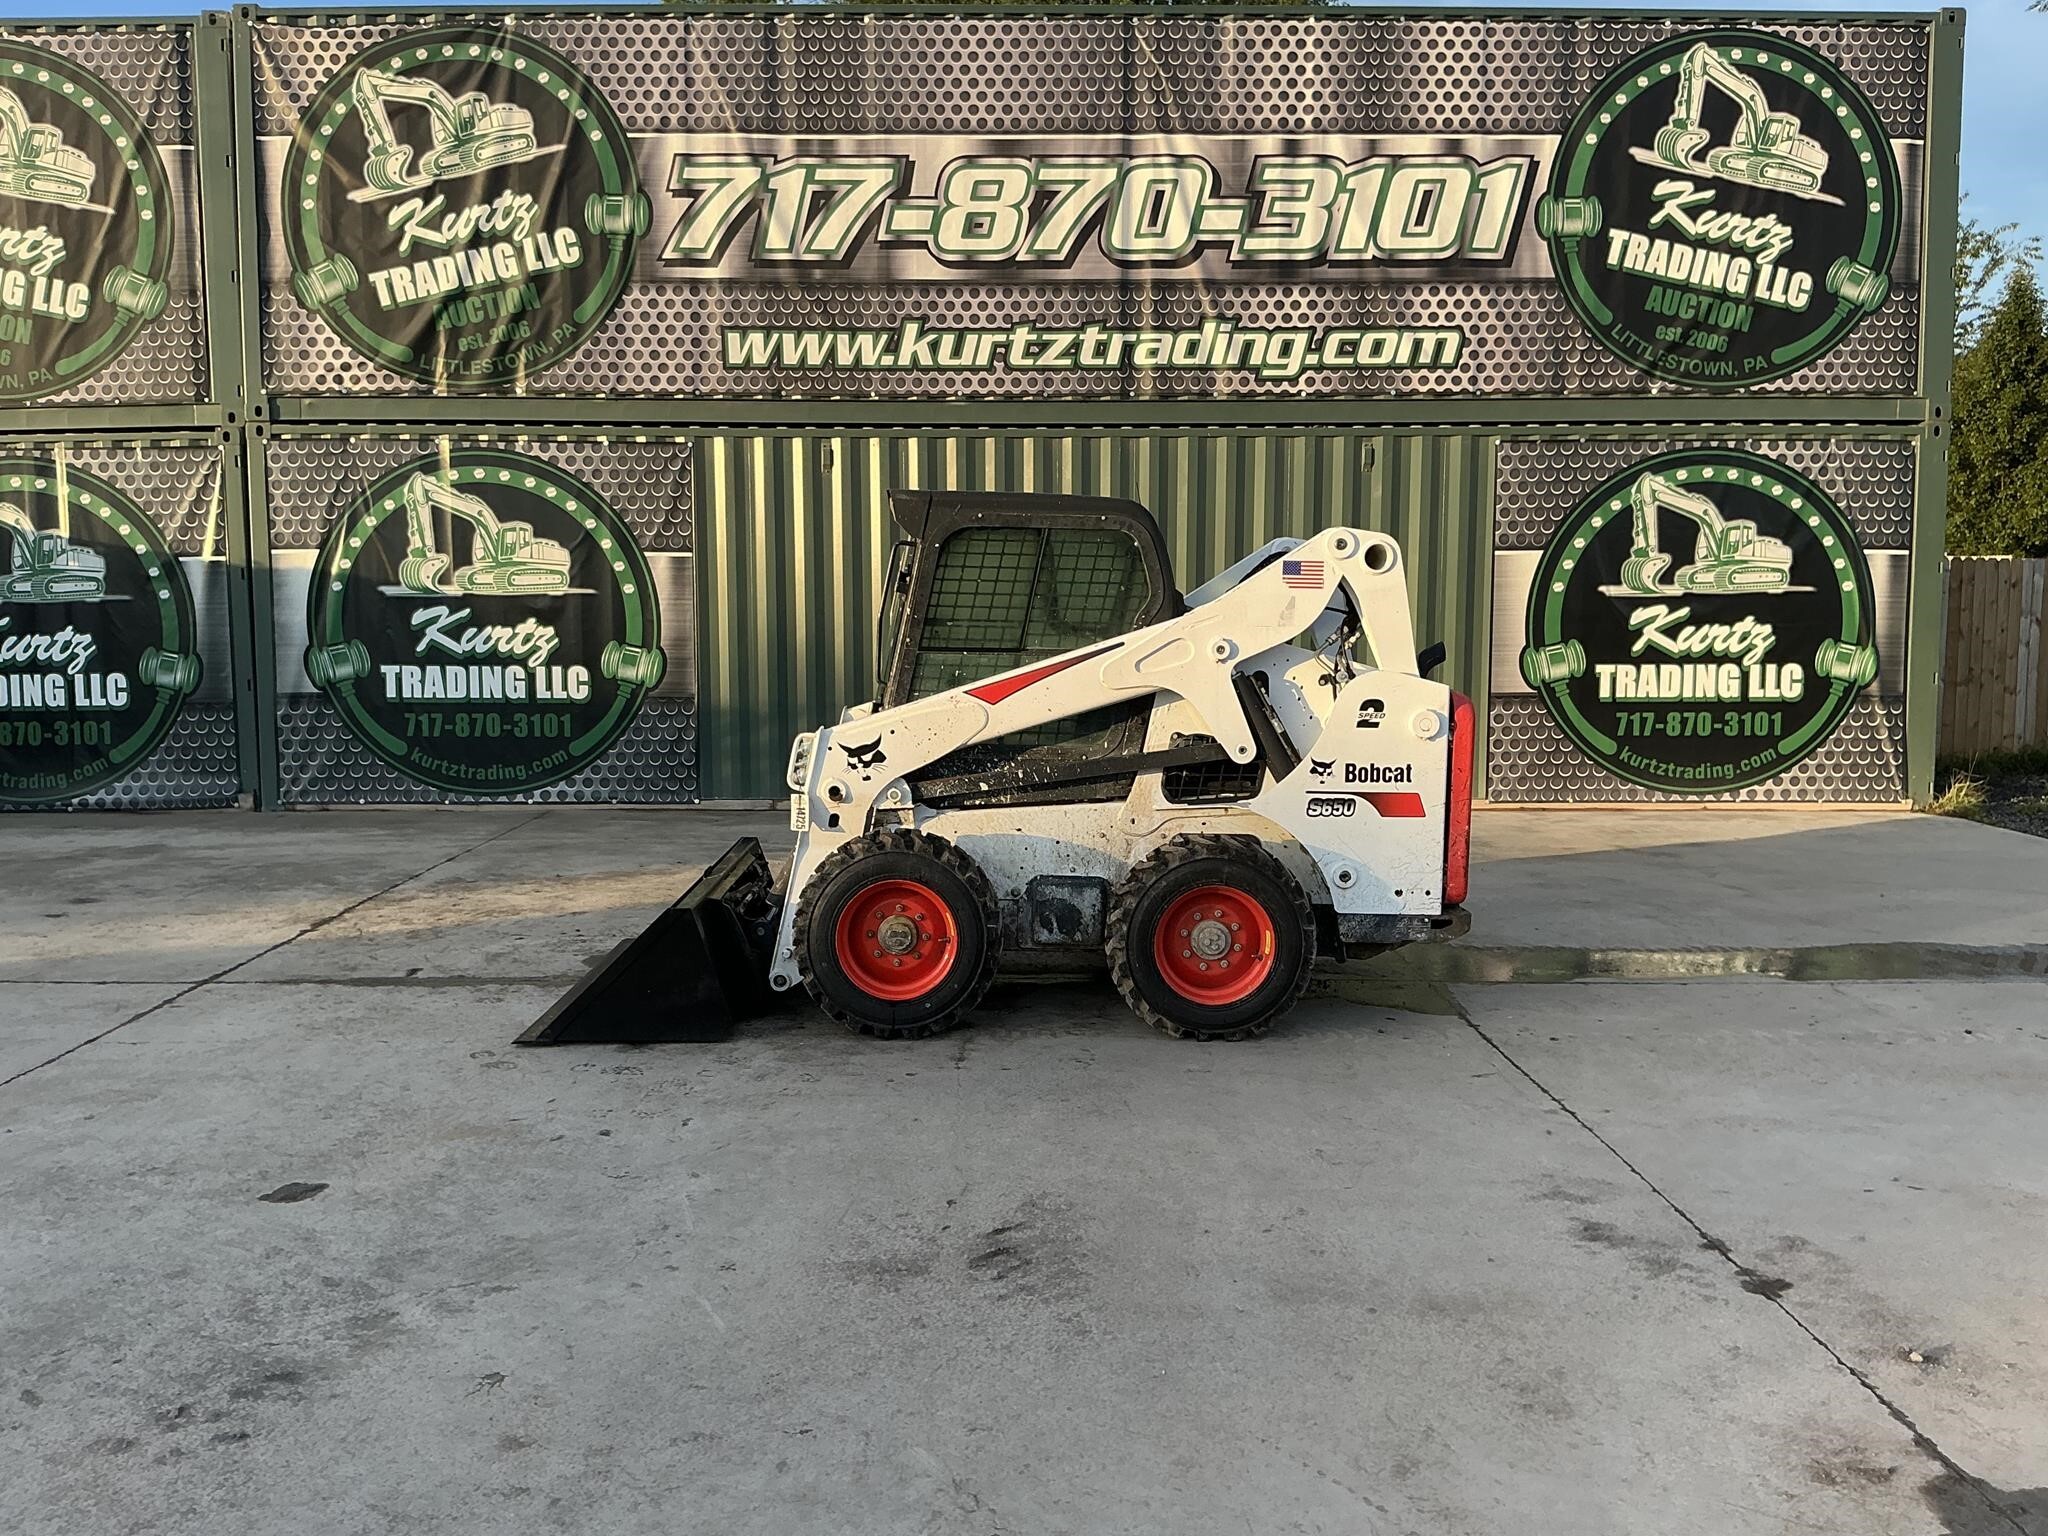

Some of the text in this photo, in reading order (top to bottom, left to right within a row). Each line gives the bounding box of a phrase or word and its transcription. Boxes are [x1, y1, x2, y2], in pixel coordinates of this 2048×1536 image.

[389, 189, 539, 253] Kurtz
[664, 155, 1530, 262] 717-870-3101
[1649, 179, 1793, 263] Kurtz
[0, 226, 66, 277] rtz
[368, 227, 582, 308] TRADING LLC
[1607, 229, 1813, 311] TRADING LLC
[32, 276, 90, 322] LLC
[433, 283, 541, 330] AUCTION
[1645, 286, 1754, 332] AUCTION
[554, 323, 577, 345] PA
[725, 321, 1463, 378] www.kurtztrading.com
[1689, 330, 1728, 353] 2006
[1744, 358, 1768, 372] PA
[0, 617, 96, 675] urtz
[411, 606, 559, 667] Kurtz
[1628, 604, 1775, 666] Kurtz
[75, 673, 129, 708] LLC
[381, 665, 591, 702] TRADING LLC
[1595, 664, 1803, 701] TRADING LLC
[404, 713, 572, 738] 717-870-3101
[1616, 711, 1782, 736] 717-870-3101
[0, 757, 108, 789] trading.com
[410, 749, 568, 780] kurtztrading.com
[1345, 763, 1412, 783] Bobcat
[1619, 746, 1777, 779] kurtztrading.com
[1306, 798, 1356, 817] S650
